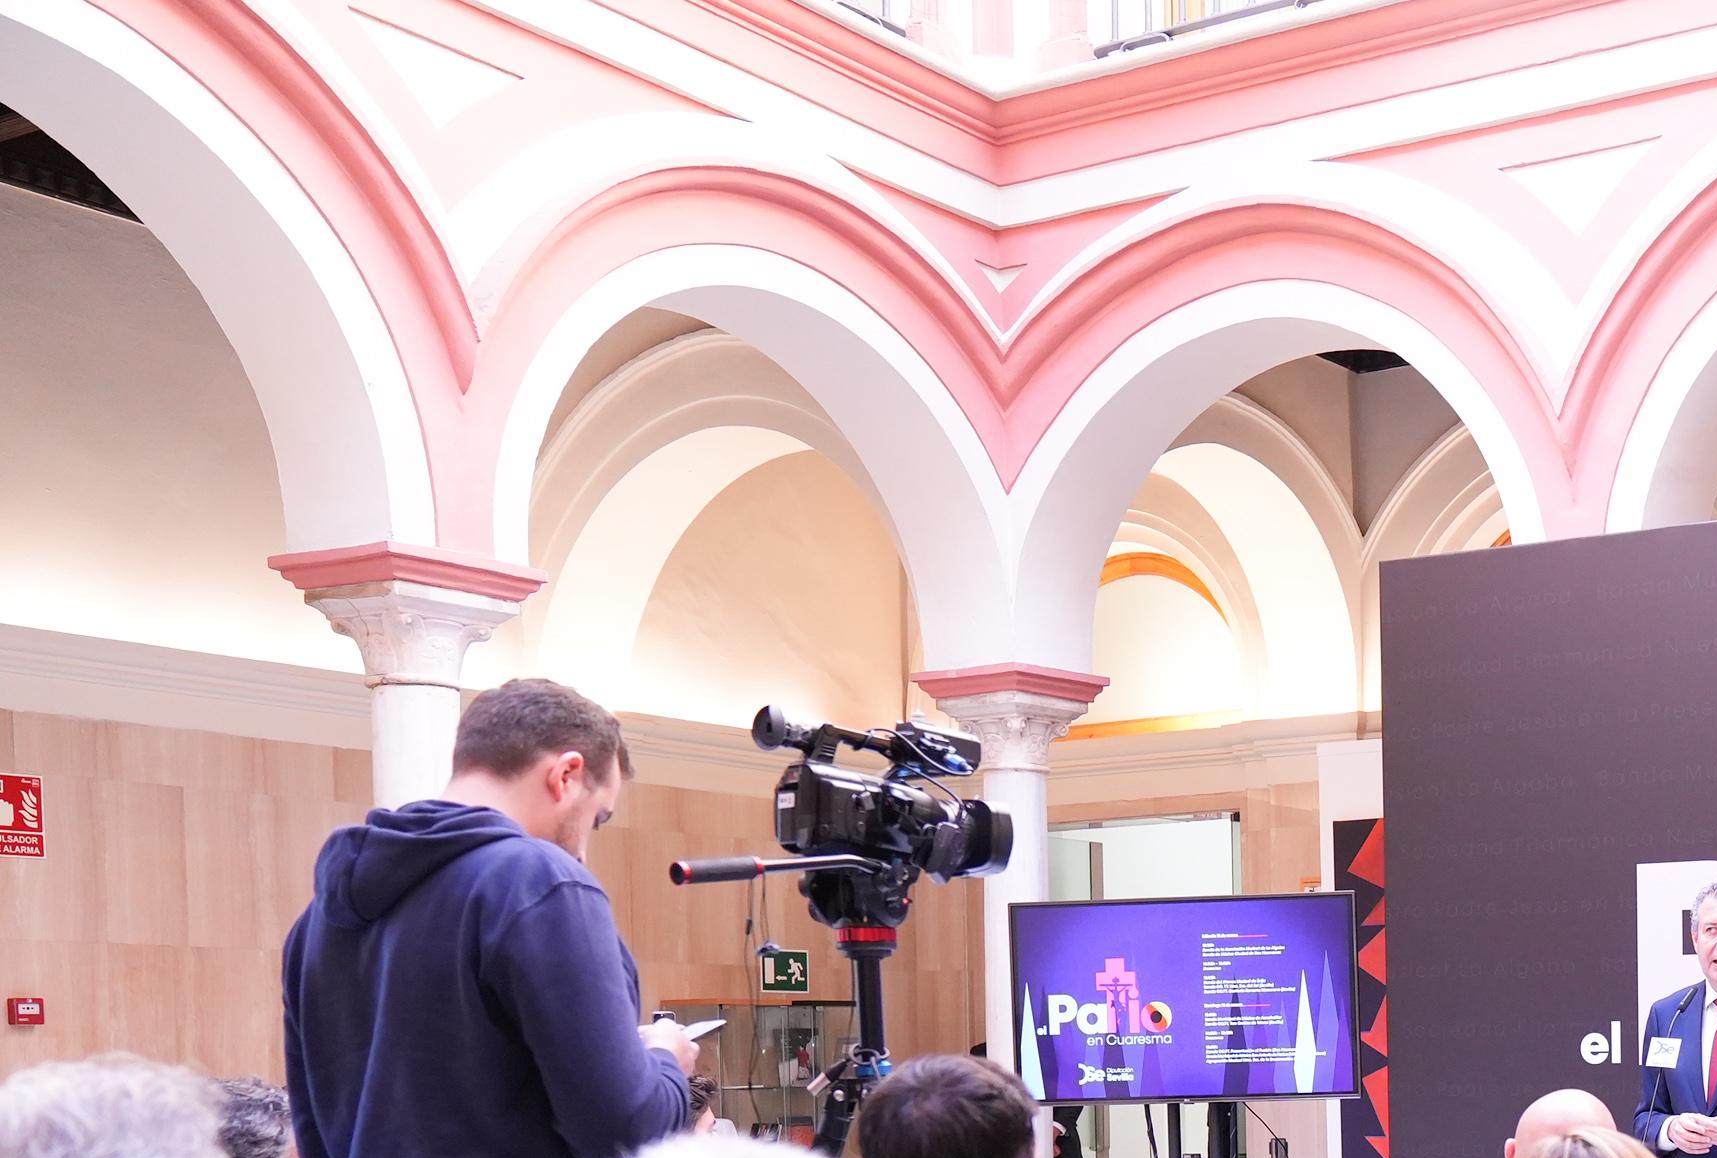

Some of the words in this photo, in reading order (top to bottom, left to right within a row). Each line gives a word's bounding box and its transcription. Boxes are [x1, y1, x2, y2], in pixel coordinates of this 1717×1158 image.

[3, 844, 41, 855] ALARMA
[1087, 1035, 1104, 1047] en
[1106, 1033, 1173, 1046] Cuaresma
[1580, 1020, 1622, 1065] el
[1106, 1073, 1135, 1082] Sevilla
